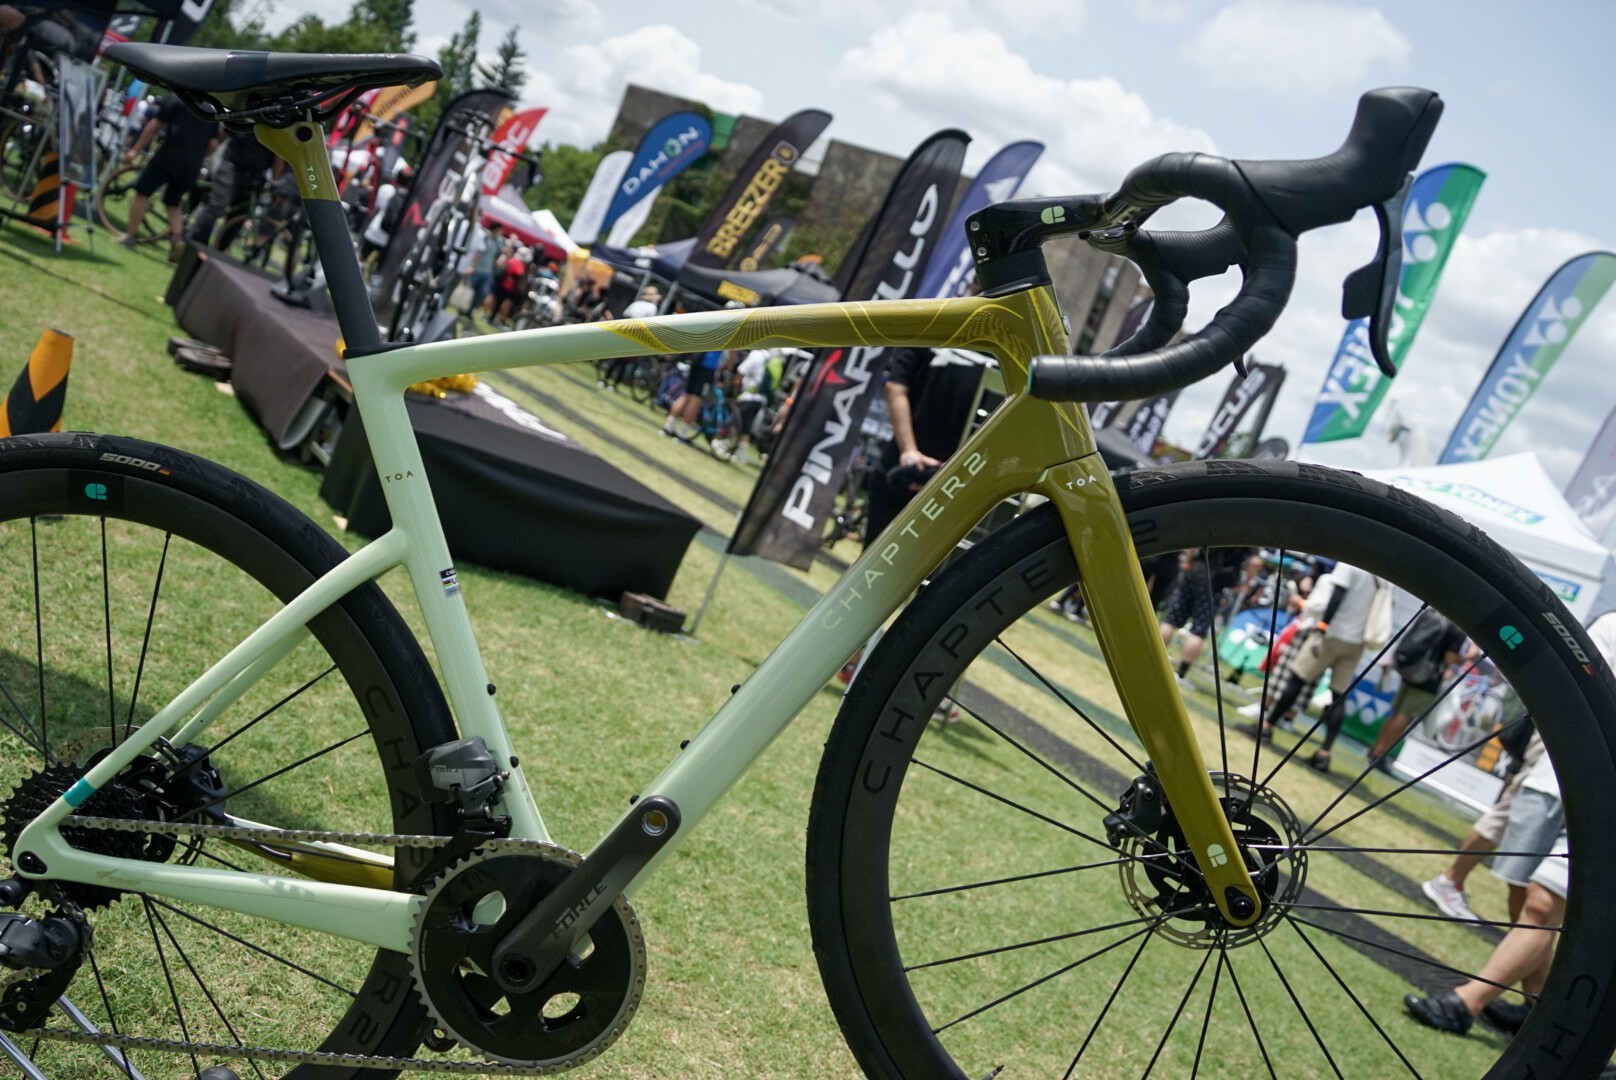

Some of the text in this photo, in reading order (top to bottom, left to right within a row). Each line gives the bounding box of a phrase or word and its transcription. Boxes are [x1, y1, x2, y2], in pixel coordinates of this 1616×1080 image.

[307, 166, 318, 190] TOA
[622, 126, 699, 196] DAHON
[706, 157, 790, 258] BREEZER
[782, 183, 938, 531] PINARLLO
[99, 452, 162, 471] 5000
[385, 471, 413, 482] TOA
[1066, 475, 1097, 490] TOA
[822, 452, 987, 630] CHAPTER2
[862, 518, 1160, 795] CHAPTE2
[1541, 612, 1591, 663] 5000
[552, 883, 608, 940] FORCE
